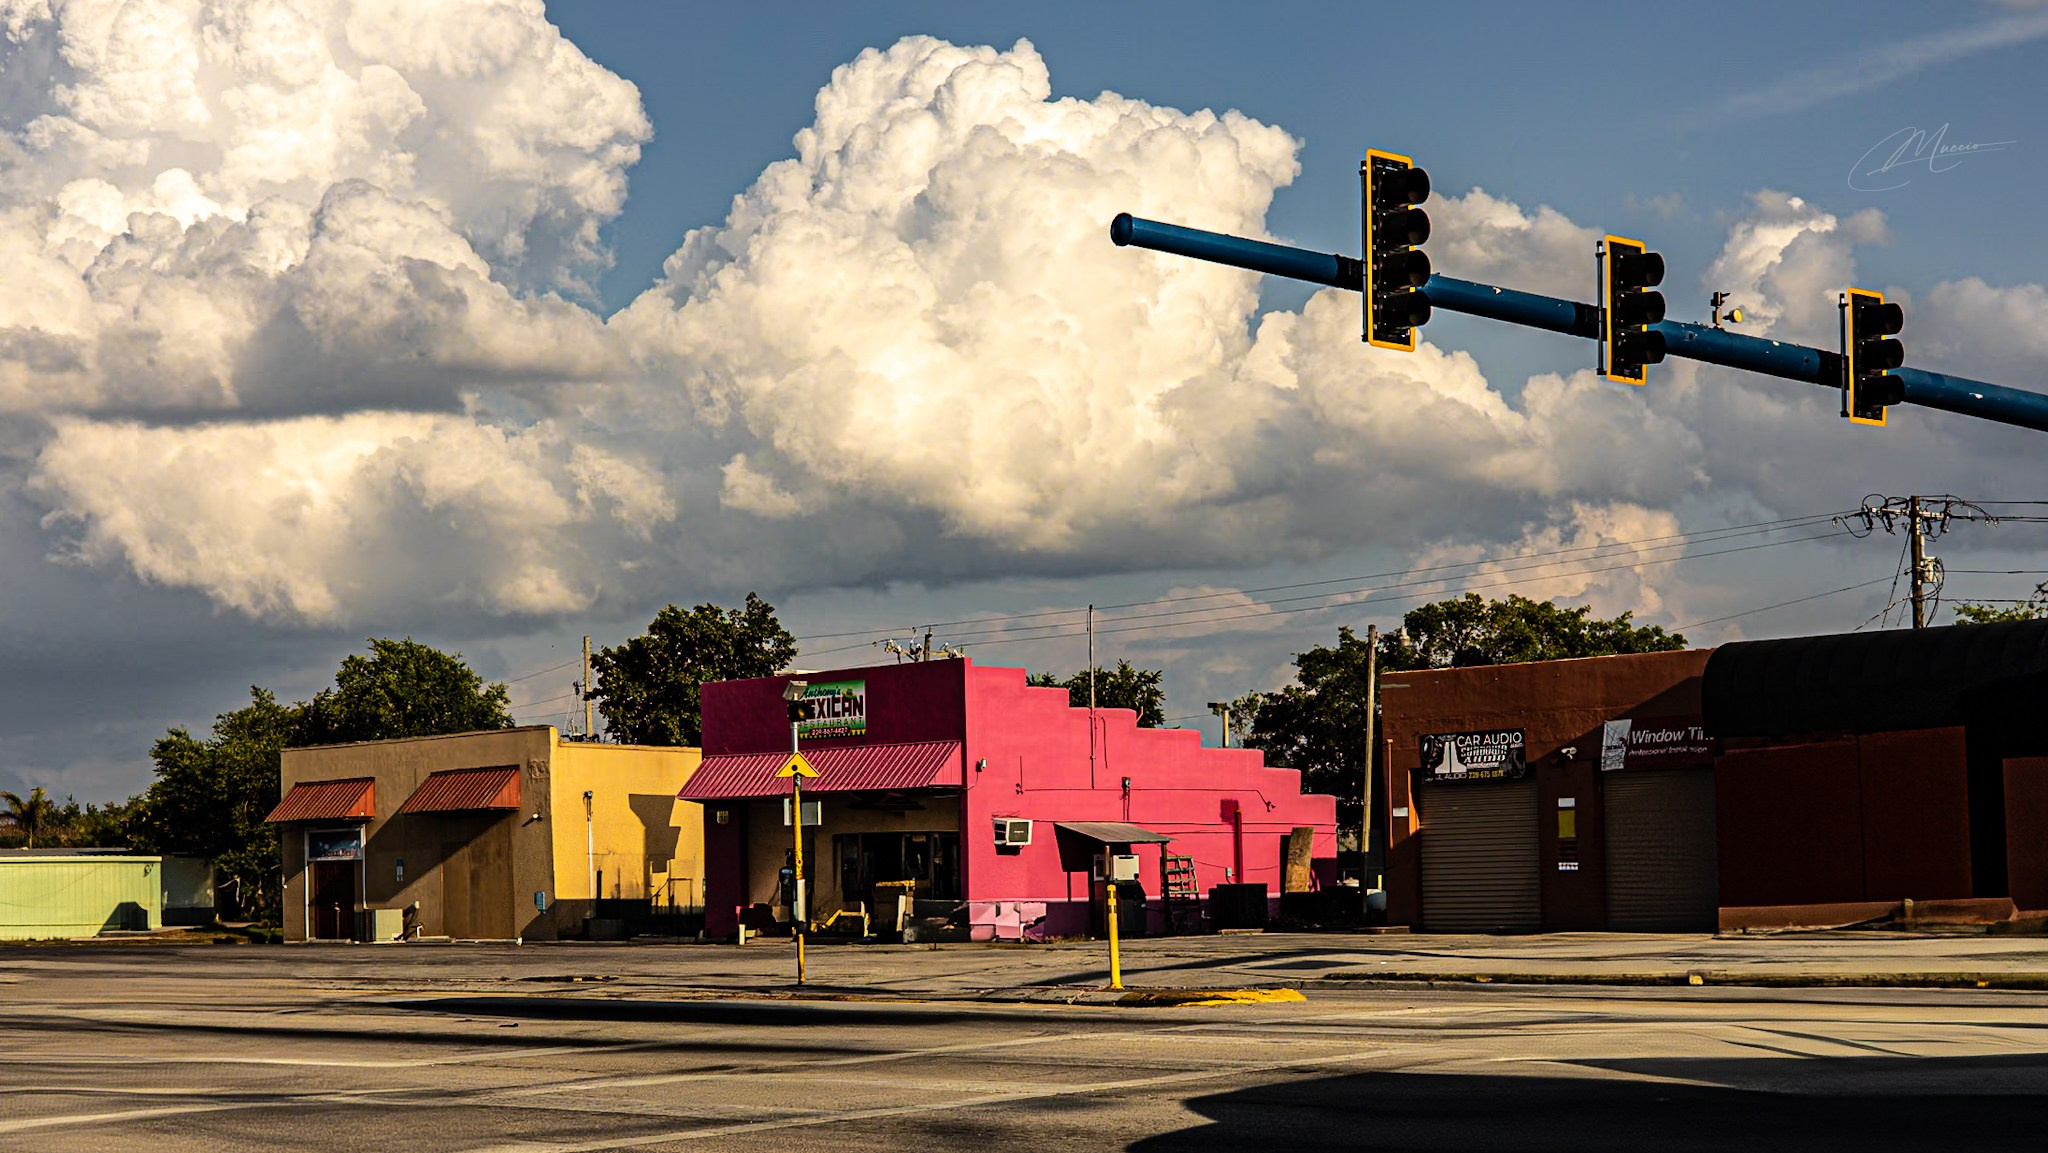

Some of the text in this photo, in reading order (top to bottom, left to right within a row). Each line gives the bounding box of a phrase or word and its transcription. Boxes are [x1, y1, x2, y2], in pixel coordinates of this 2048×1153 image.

[802, 694, 864, 720] EXICAN
[1457, 735, 1480, 747] CAR
[1483, 732, 1522, 745] AUDIO
[1632, 729, 1685, 744] Window
